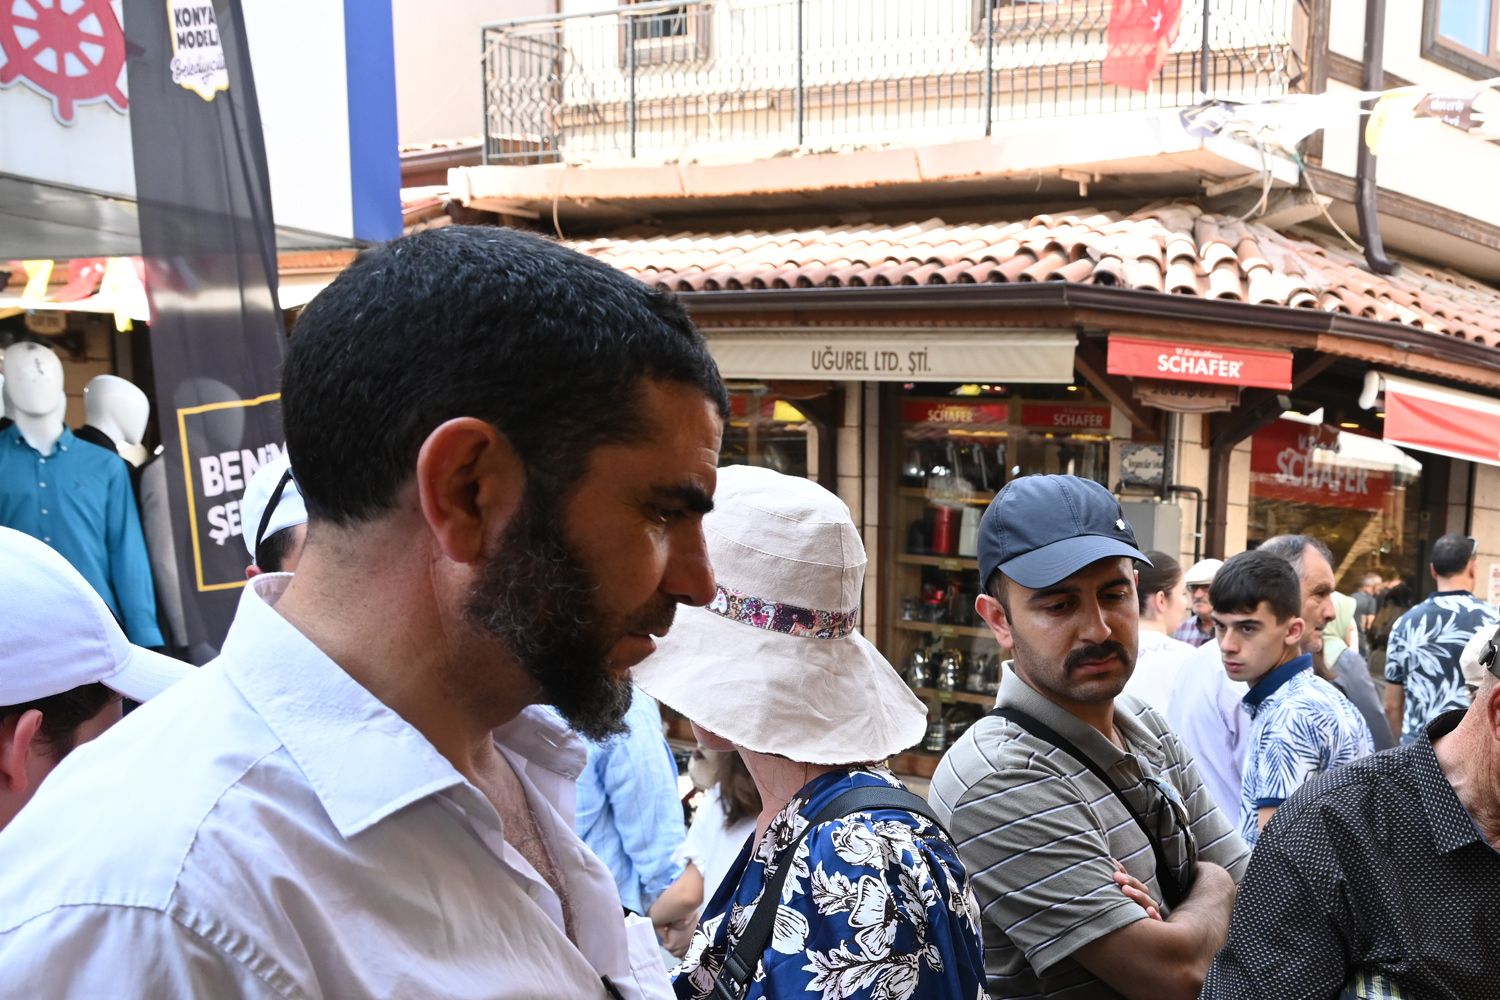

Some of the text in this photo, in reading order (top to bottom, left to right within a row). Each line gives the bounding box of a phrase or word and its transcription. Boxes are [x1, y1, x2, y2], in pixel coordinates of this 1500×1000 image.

[811, 345, 931, 375] UĞUREL LTD. ŞTİ.
[1157, 354, 1240, 378] SCHAFER
[927, 409, 974, 423] SCHAFER
[1053, 413, 1104, 426] SCHAFER
[1275, 449, 1369, 495] SCHAFER
